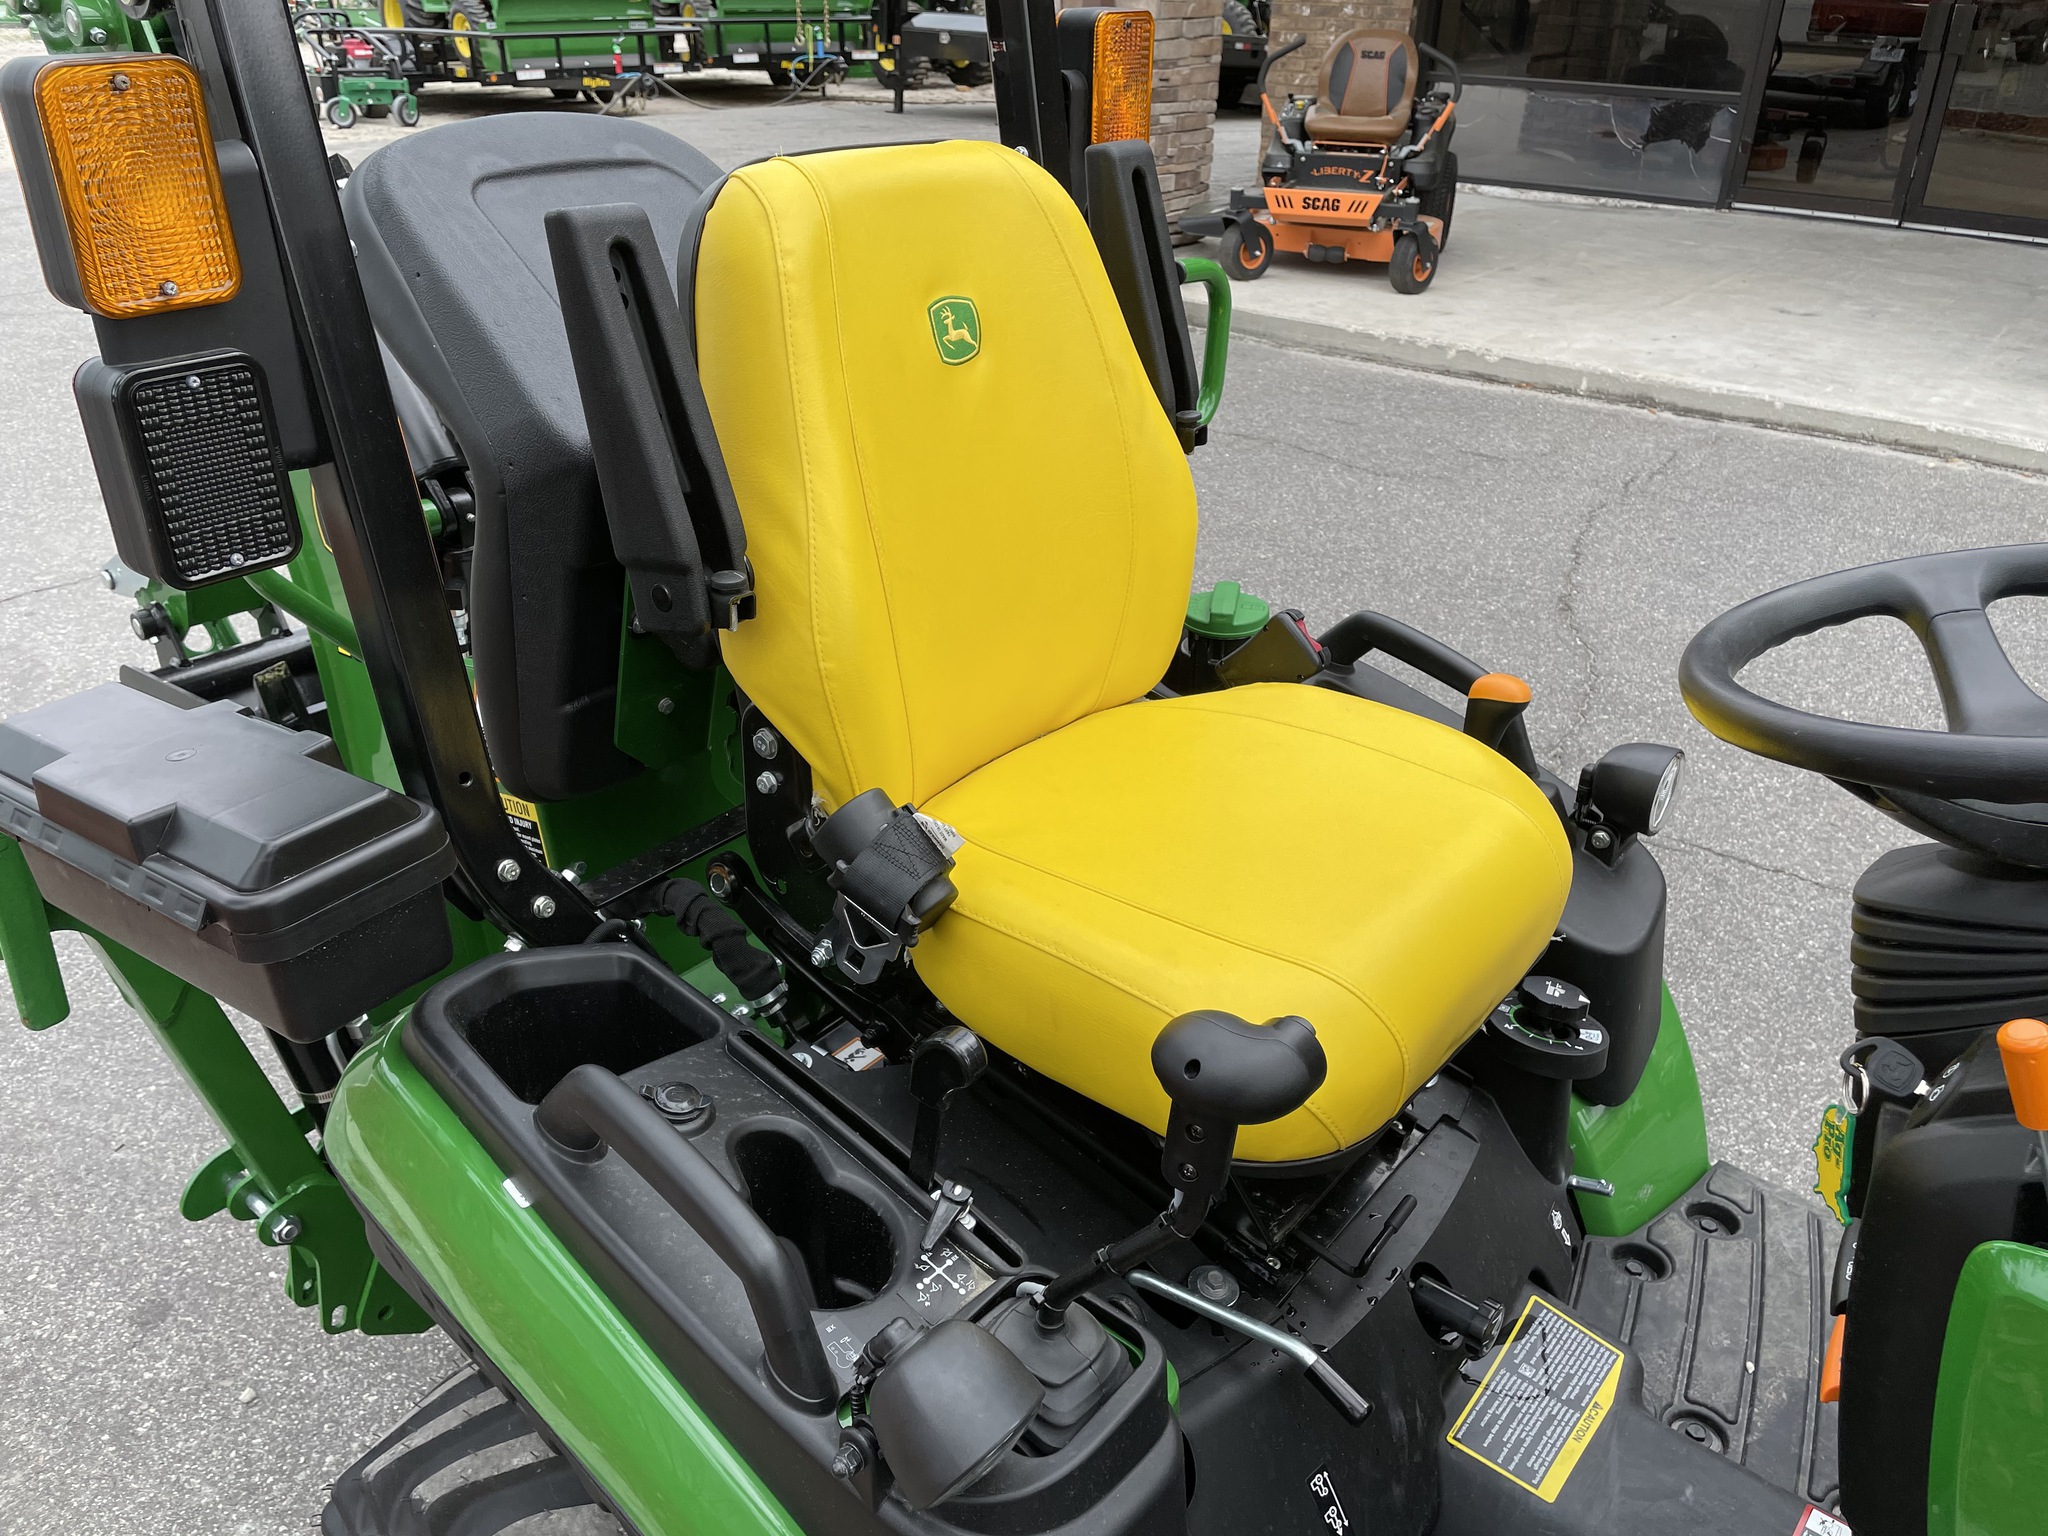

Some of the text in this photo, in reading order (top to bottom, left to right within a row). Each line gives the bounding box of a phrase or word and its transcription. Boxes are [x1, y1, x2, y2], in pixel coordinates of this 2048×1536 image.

[1361, 50, 1386, 60] SCAG
[1312, 166, 1375, 183] LIBERTY Z
[1302, 196, 1341, 212] SCAG
[1571, 1405, 1599, 1444] CAUTION
